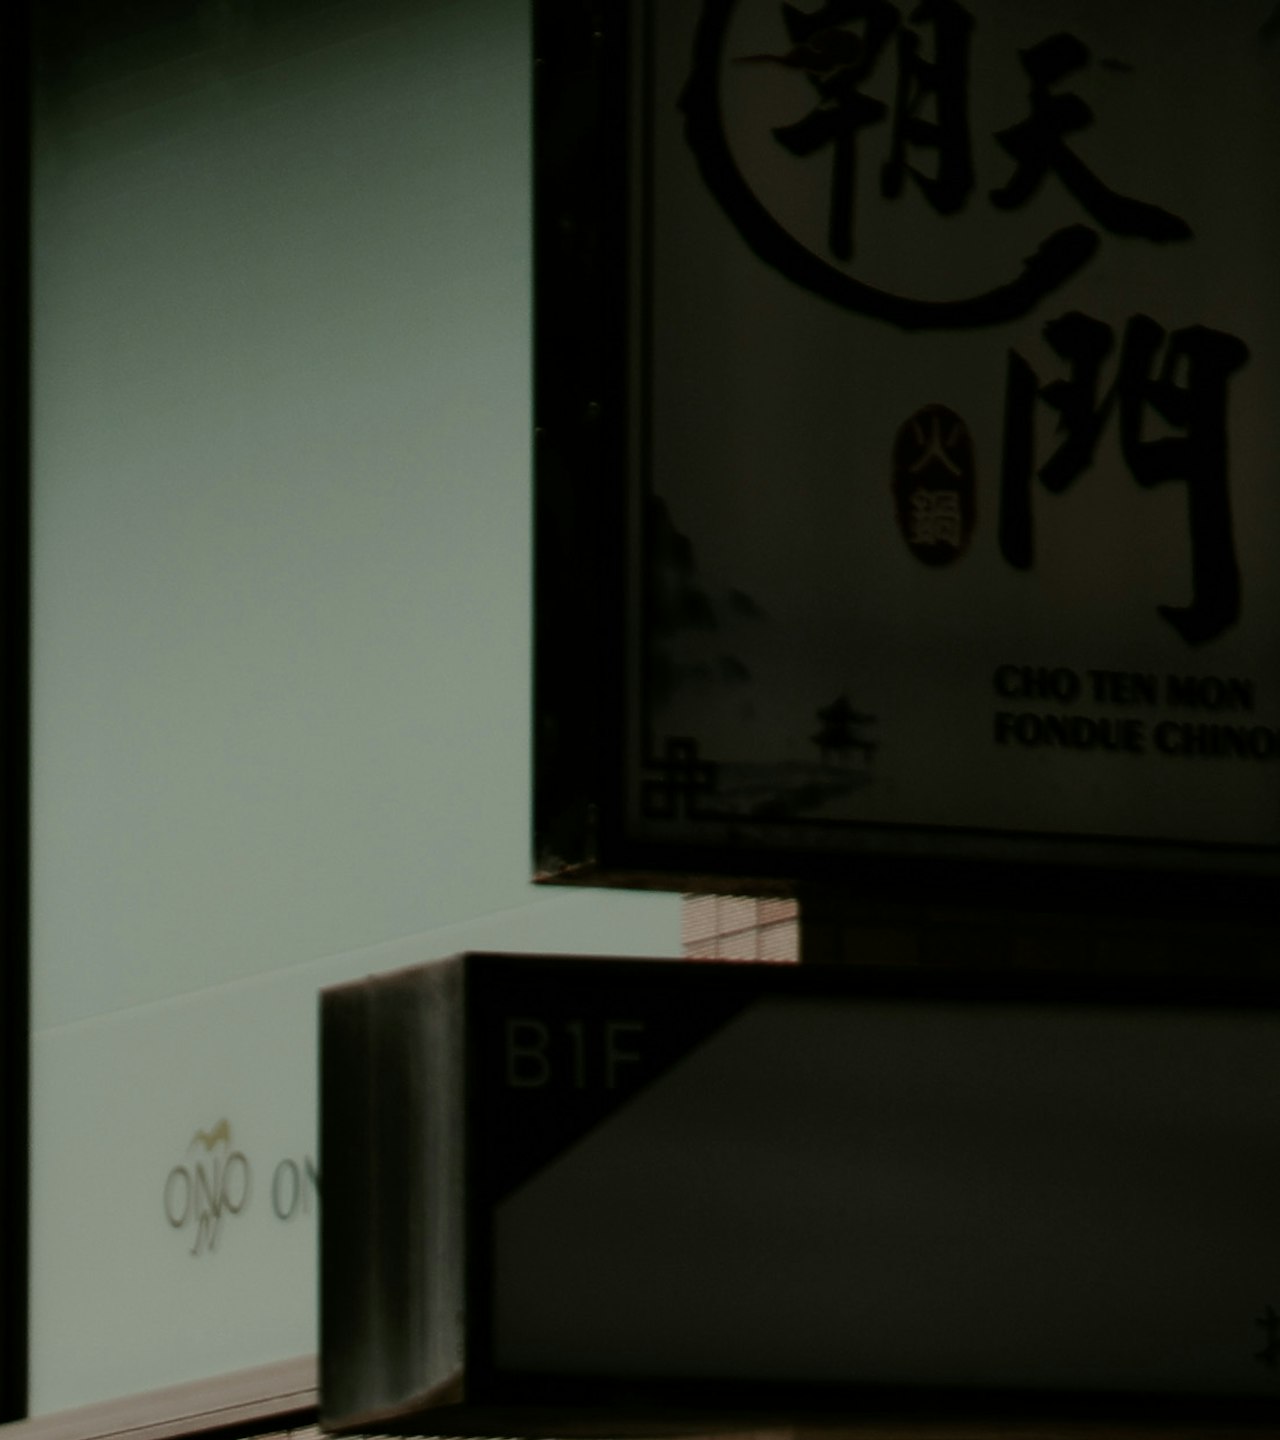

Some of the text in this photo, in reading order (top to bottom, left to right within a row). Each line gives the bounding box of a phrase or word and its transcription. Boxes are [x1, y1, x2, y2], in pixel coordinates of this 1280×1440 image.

[994, 664, 1255, 710] CHO TEN MON
[994, 711, 1280, 760] FONDUE CHINO
[501, 1015, 649, 1092] B1F
